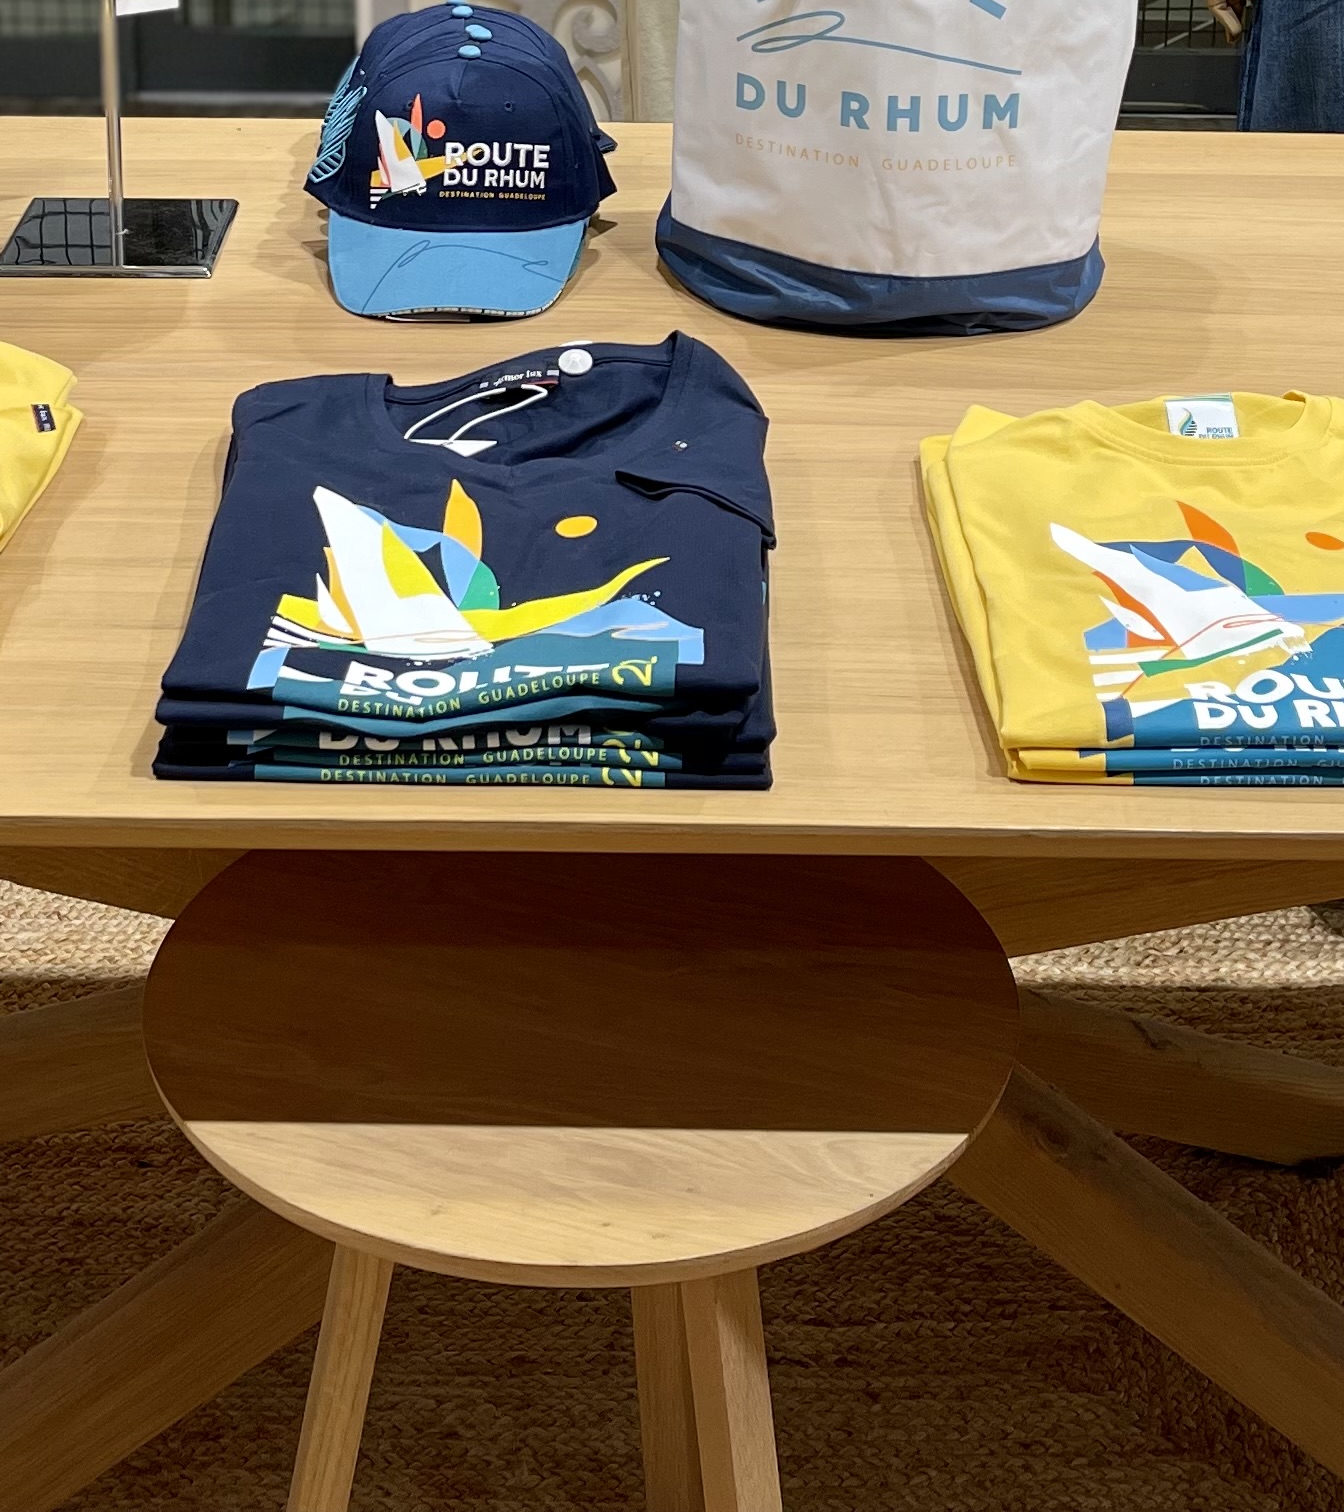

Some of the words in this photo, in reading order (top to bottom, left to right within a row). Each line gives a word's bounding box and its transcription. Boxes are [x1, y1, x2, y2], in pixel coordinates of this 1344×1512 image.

[735, 72, 807, 118] DU
[840, 91, 1020, 132] RHUM
[445, 141, 550, 169] ROUTE
[735, 133, 860, 169] DESTINATION
[882, 154, 1017, 172] GUADELOUPE
[443, 168, 478, 186] DU
[484, 169, 545, 189] RHUM
[439, 190, 495, 199] DESTINATION
[498, 192, 546, 201] GUADELOUPE
[337, 697, 462, 718] DESTINATION
[478, 672, 601, 705] GUADELOUPE
[1193, 701, 1279, 730] DU
[1200, 734, 1325, 746] DESTINATION
[339, 753, 465, 766] DESTINATION
[482, 747, 607, 763] GUADELOUPE
[320, 769, 447, 784] DESTINATION
[466, 773, 591, 785] GUADELOUPE
